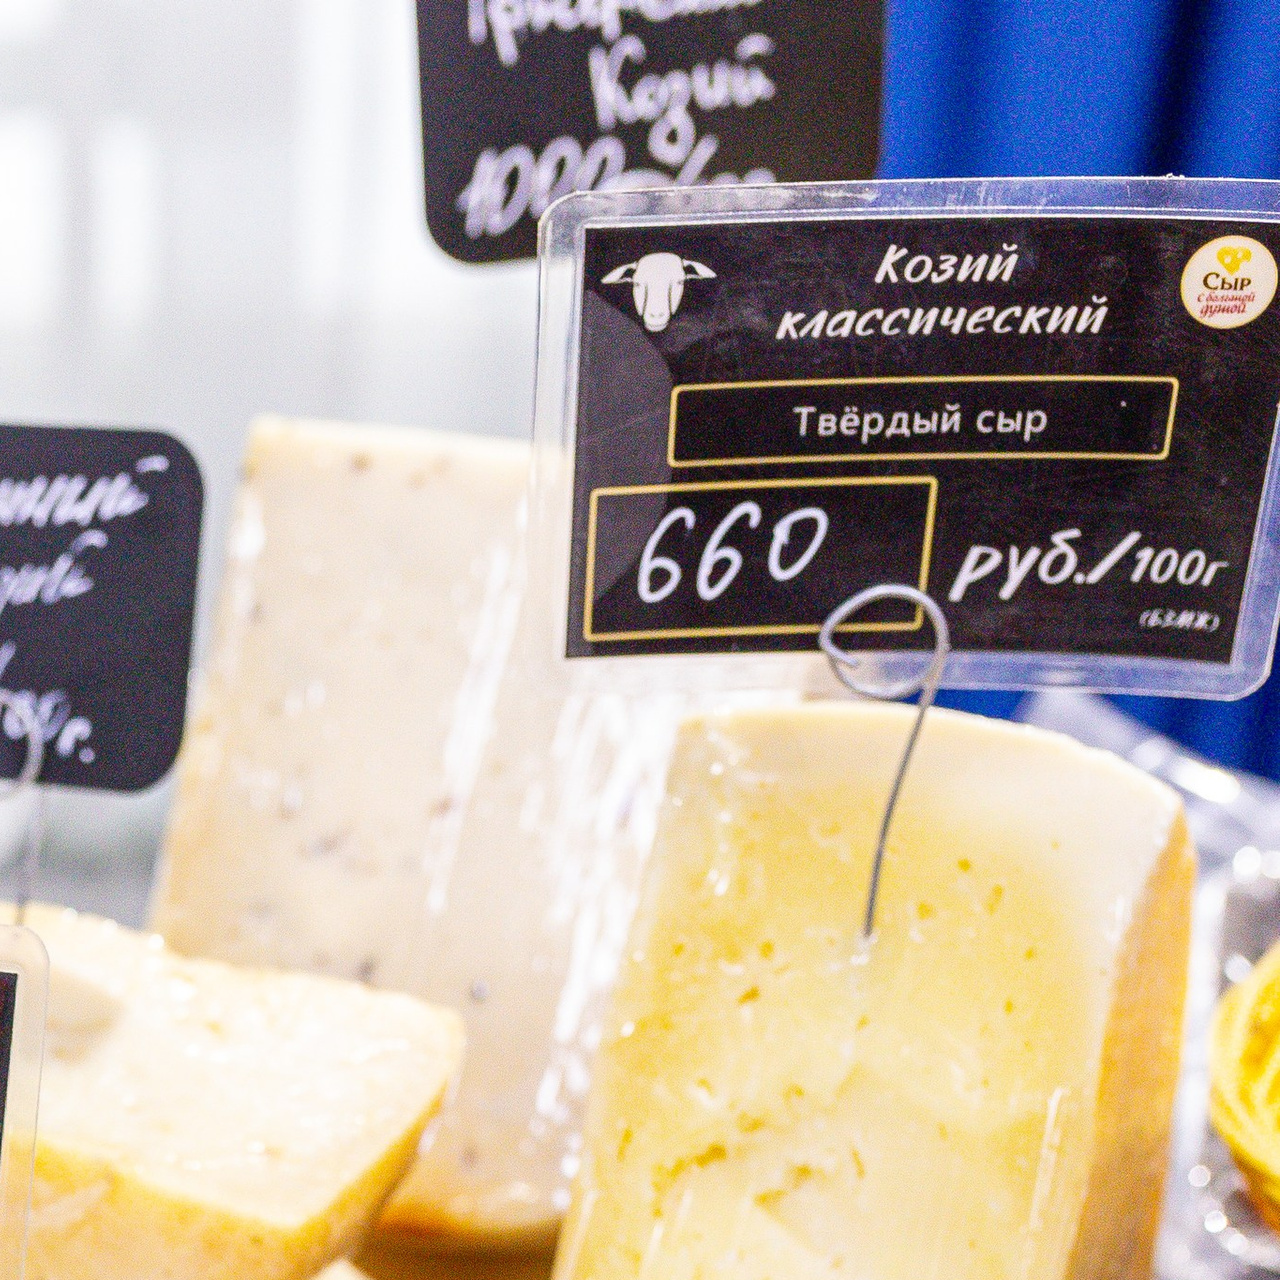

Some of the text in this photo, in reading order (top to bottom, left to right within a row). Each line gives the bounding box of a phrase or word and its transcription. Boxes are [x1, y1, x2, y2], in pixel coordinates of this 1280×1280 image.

[874, 243, 1019, 284] Козий
[776, 295, 1109, 340] классический
[792, 403, 1048, 444] Твёрдый сыр
[637, 500, 829, 604] 660
[948, 527, 1229, 602] руб./100г
